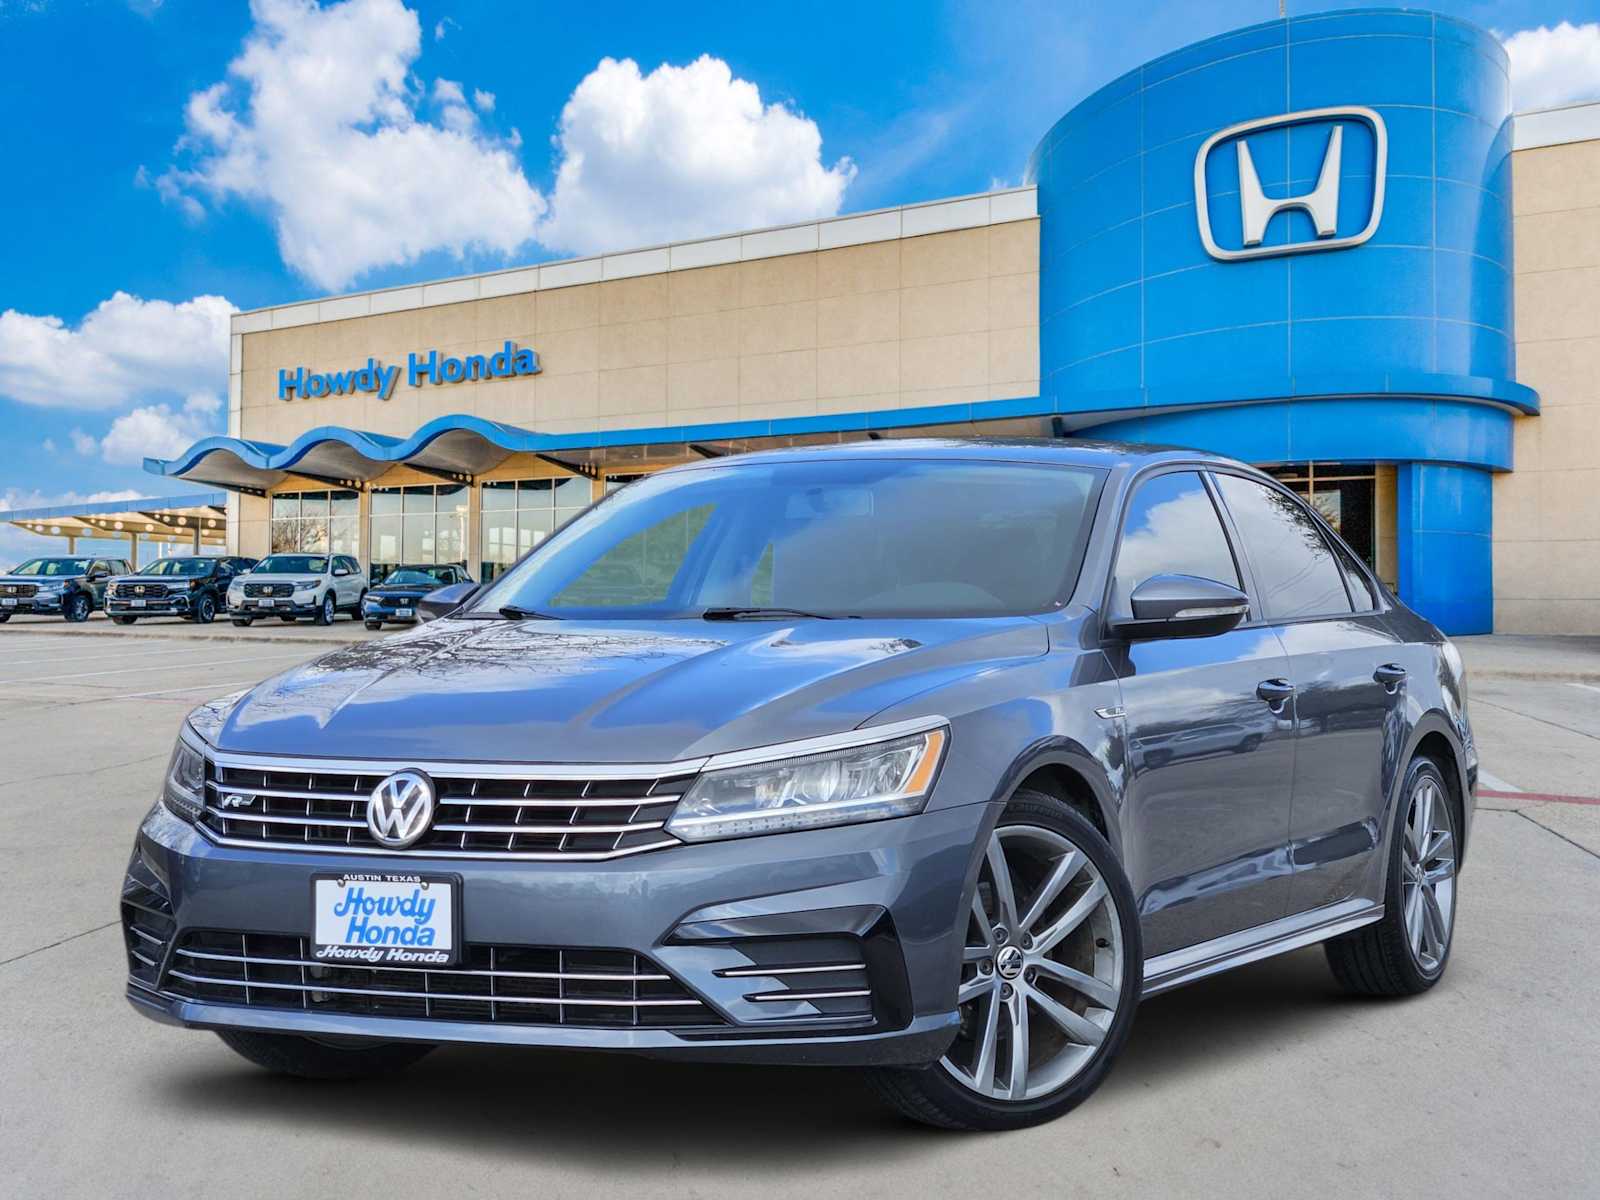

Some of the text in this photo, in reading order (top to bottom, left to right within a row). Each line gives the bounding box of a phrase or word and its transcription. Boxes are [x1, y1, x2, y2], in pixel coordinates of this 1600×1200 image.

[278, 340, 542, 401] Howdy Honda
[385, 875, 421, 883] TEXAS
[334, 887, 436, 925] Howdy
[345, 916, 436, 946] Honda
[315, 945, 449, 963] Howdy Honda
